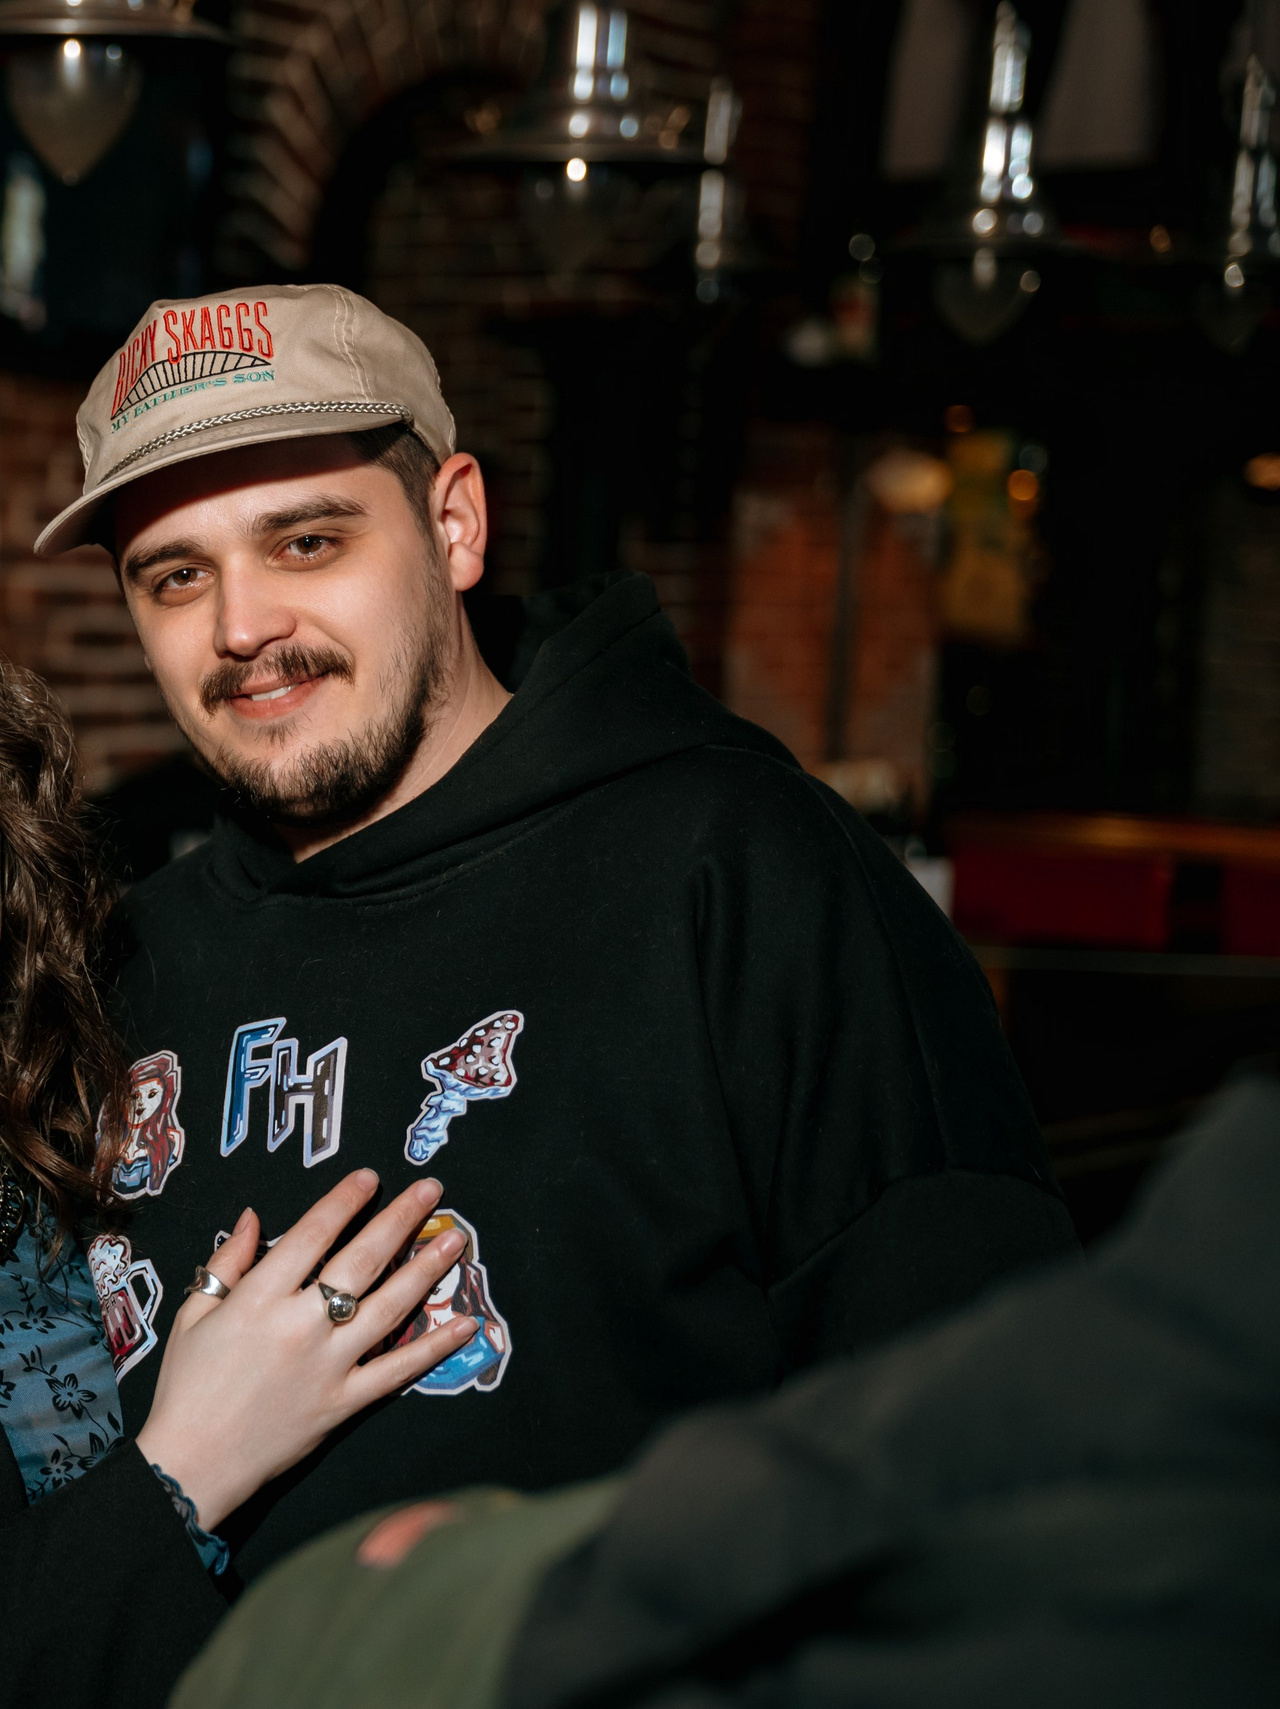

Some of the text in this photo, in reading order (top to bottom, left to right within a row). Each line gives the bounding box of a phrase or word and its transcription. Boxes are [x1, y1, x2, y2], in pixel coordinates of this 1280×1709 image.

[111, 301, 274, 416] RICKY SKAGGS
[111, 369, 275, 433] MY FATHER'S SON
[221, 1017, 348, 1168] FH
